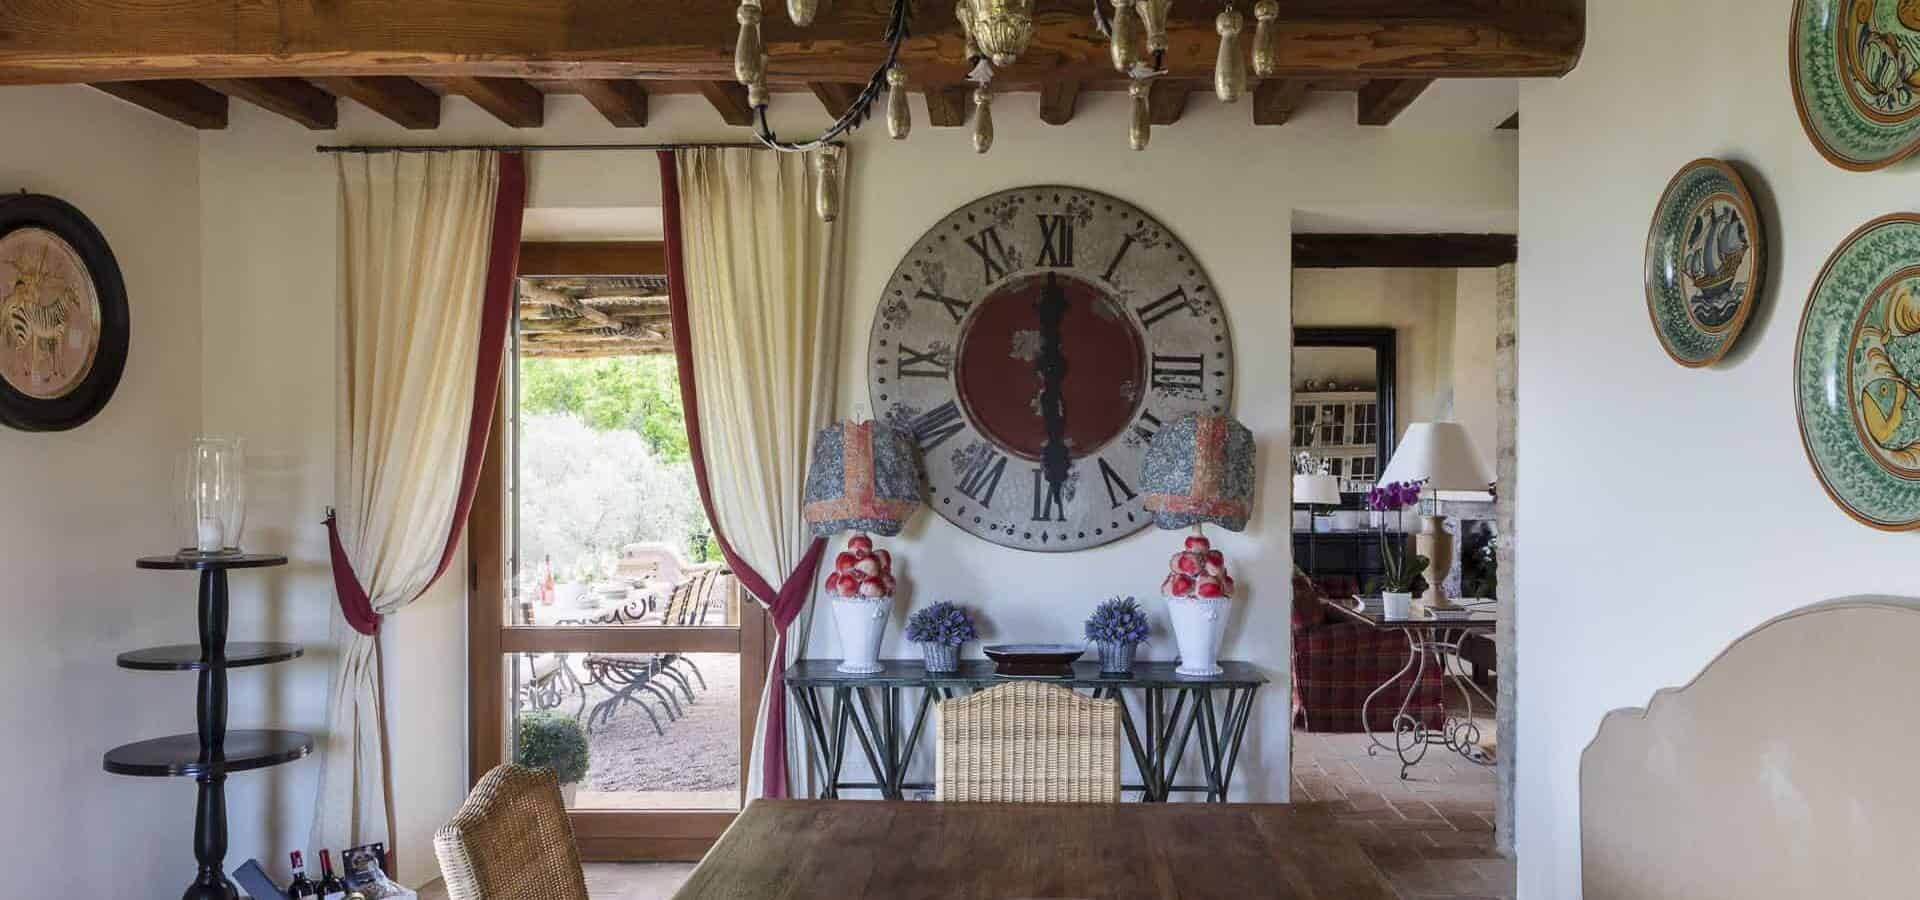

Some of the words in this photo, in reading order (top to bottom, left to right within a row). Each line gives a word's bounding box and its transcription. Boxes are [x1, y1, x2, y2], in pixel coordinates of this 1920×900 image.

[1035, 213, 1075, 267] XII
[1151, 352, 1204, 393] III
[1097, 457, 1139, 510] V
